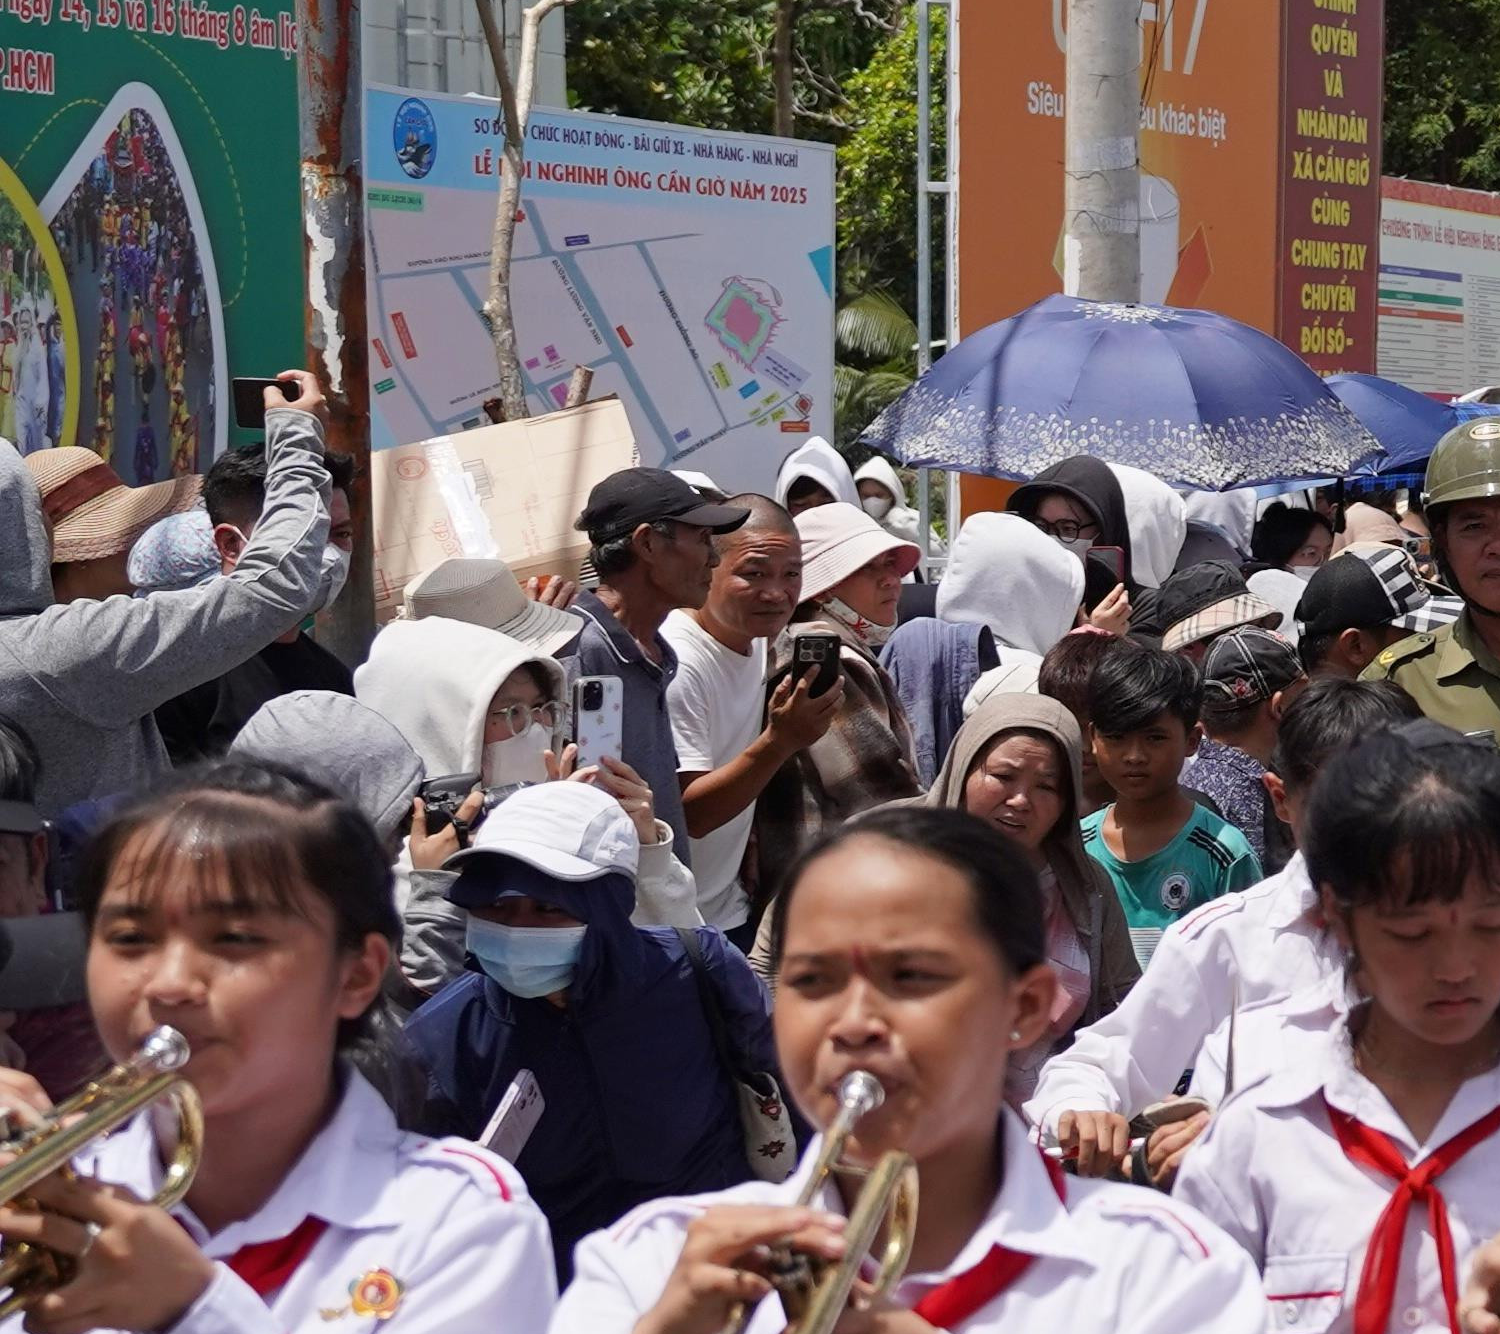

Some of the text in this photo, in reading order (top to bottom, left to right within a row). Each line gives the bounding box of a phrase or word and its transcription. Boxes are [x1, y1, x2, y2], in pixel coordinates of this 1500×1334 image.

[233, 3, 246, 46] 8
[249, 8, 277, 50] âm
[279, 10, 297, 60] lịc
[1310, 19, 1358, 58] QUYỀN
[0, 45, 55, 95] .HCM
[1323, 64, 1344, 98] VÀ
[1027, 81, 1064, 118] Siêu
[1159, 101, 1196, 137] khác
[1199, 107, 1226, 147] biệt
[1297, 105, 1368, 144] NHÂN DÂN
[531, 120, 560, 143] CHỨC
[563, 130, 592, 148] HOẠT
[594, 130, 626, 151] ĐỘNG
[673, 141, 685, 156] XE
[693, 141, 715, 159] NHÀ
[716, 141, 744, 163] HÀNG
[752, 146, 773, 166] NHÀ
[474, 148, 492, 176] LỄ
[538, 161, 609, 186] NGHINH
[614, 166, 652, 189] ÔNG
[696, 175, 726, 197] GIỜ
[730, 179, 765, 201] NĂM
[770, 185, 808, 204] 2025
[1292, 147, 1313, 180] XÃ
[1345, 152, 1370, 187] GIỜ
[1311, 191, 1350, 227] CÙNG
[1290, 238, 1368, 271] CHUNG TAY
[1301, 274, 1356, 312] CHUYỂN
[1300, 316, 1345, 354] ĐỔI SỐ
